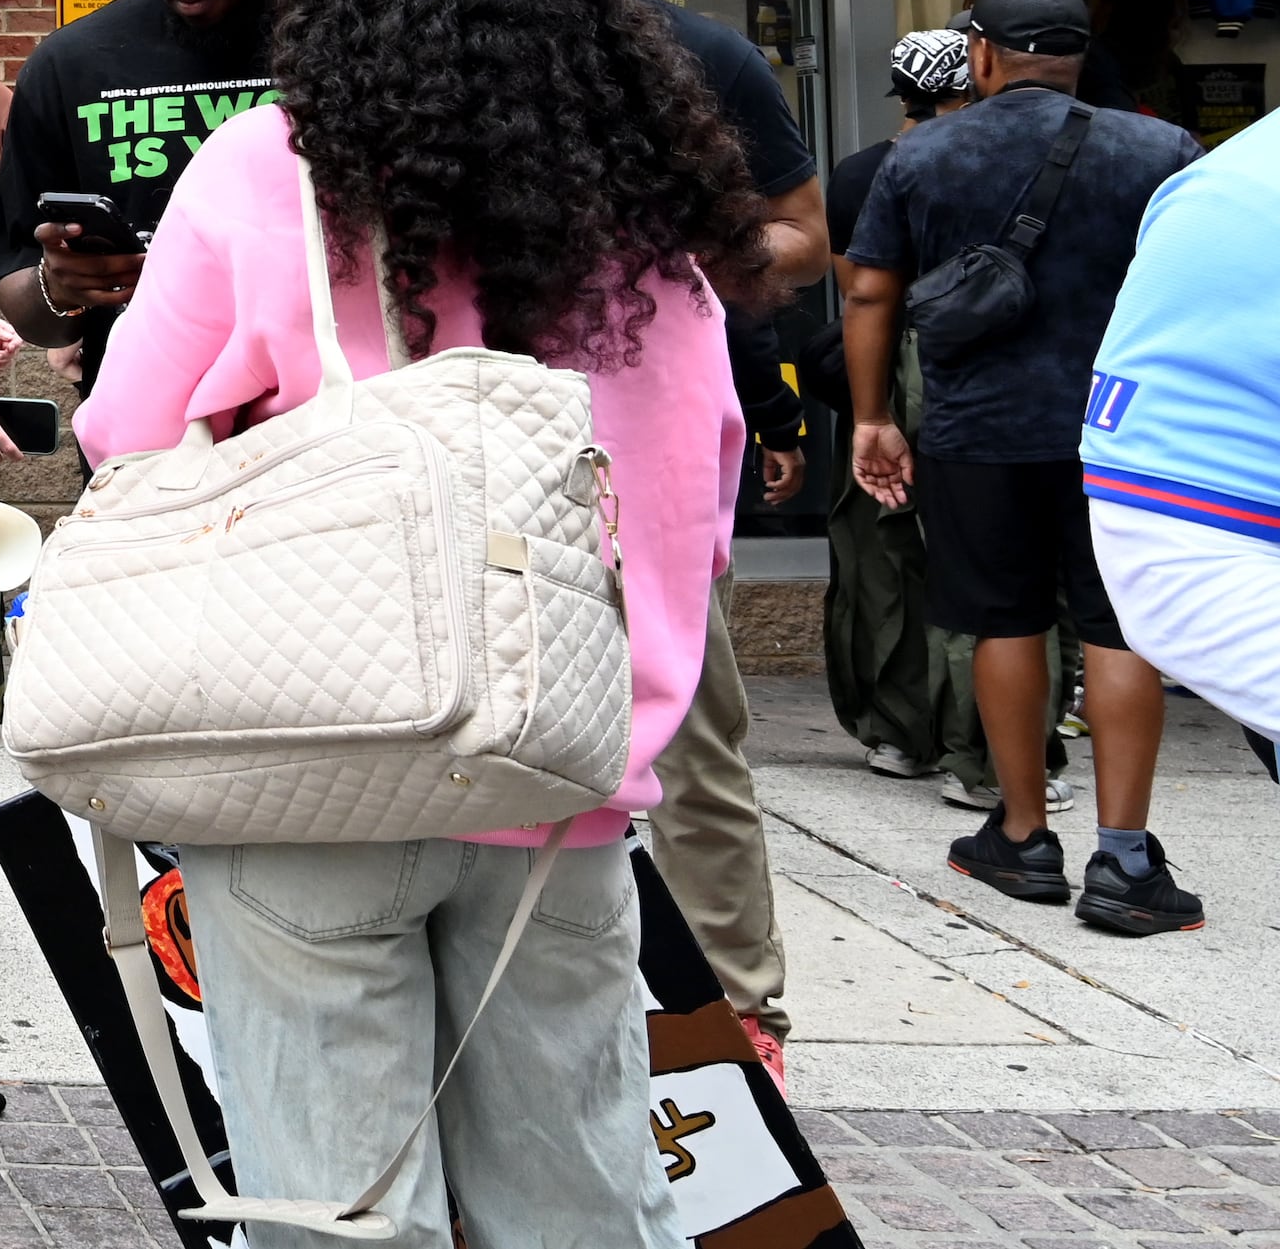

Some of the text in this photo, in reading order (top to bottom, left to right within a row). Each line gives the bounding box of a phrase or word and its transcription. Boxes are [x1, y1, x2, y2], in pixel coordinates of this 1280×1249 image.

[101, 88, 138, 99] PUBLIC
[140, 84, 183, 97] SERVICE
[184, 78, 271, 92] ANNOUNCEMENT
[77, 96, 186, 143] THE
[108, 136, 169, 183] IS
